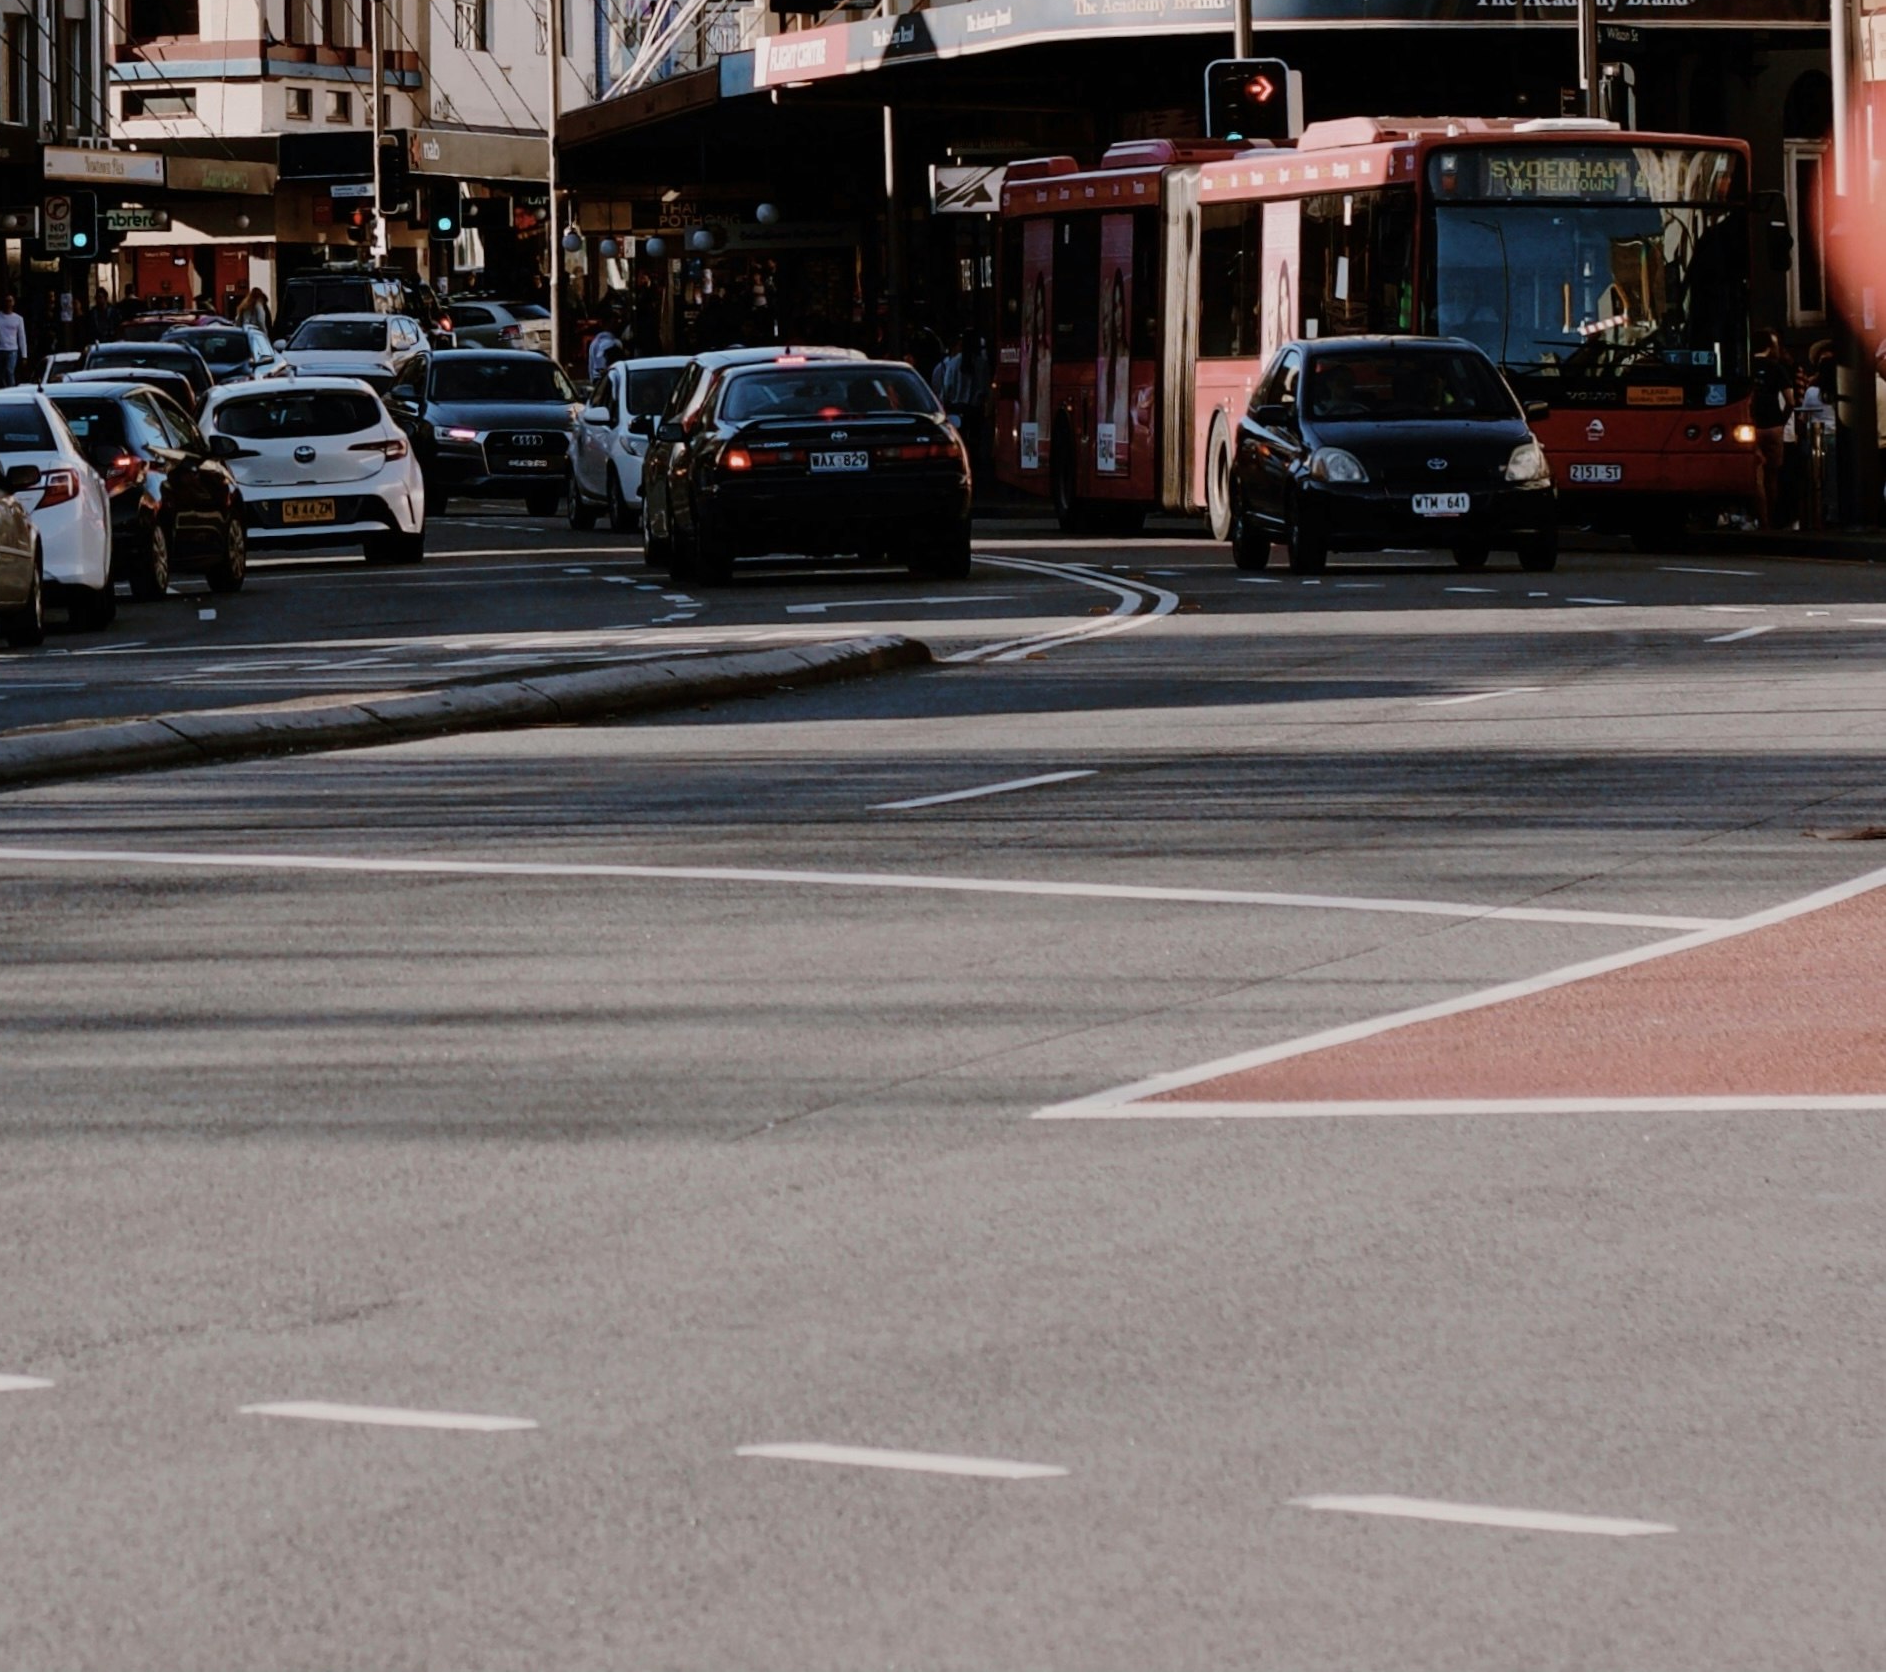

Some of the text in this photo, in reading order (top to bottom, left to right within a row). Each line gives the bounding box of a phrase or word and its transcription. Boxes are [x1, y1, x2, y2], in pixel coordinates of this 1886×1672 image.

[423, 137, 440, 161] nab
[1489, 160, 1628, 178] SYDENHAM
[1505, 177, 1616, 192] VIA NEWTOWN
[660, 202, 697, 215] THAI
[50, 223, 65, 232] NO
[659, 213, 743, 228] POTHONG
[812, 454, 868, 469] WAX 829
[1572, 466, 1621, 479] 2151 ST
[1447, 496, 1466, 509] 641
